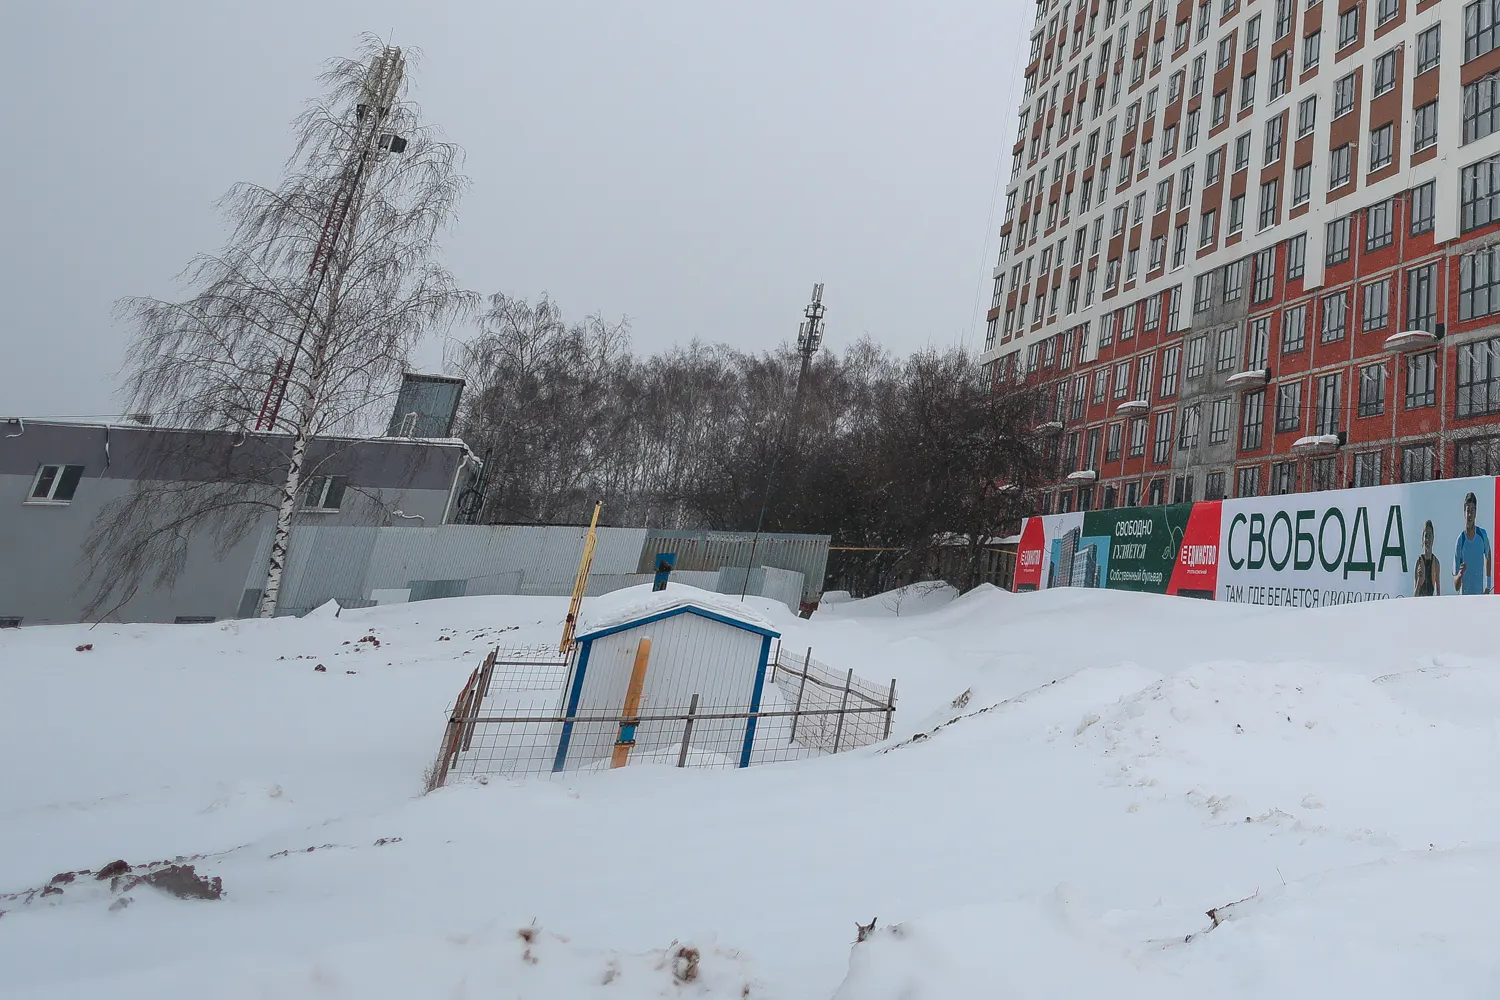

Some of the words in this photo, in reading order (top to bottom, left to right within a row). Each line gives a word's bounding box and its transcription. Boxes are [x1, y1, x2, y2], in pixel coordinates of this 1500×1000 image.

[1115, 519, 1153, 538] СВОБОДНО
[1228, 505, 1408, 581] СВОБОДА
[1110, 568, 1142, 583] Собственный
[1142, 569, 1163, 586] бульвар
[1249, 586, 1266, 605] ГДЕ
[1268, 587, 1320, 608] БЕГАЕТСЯ
